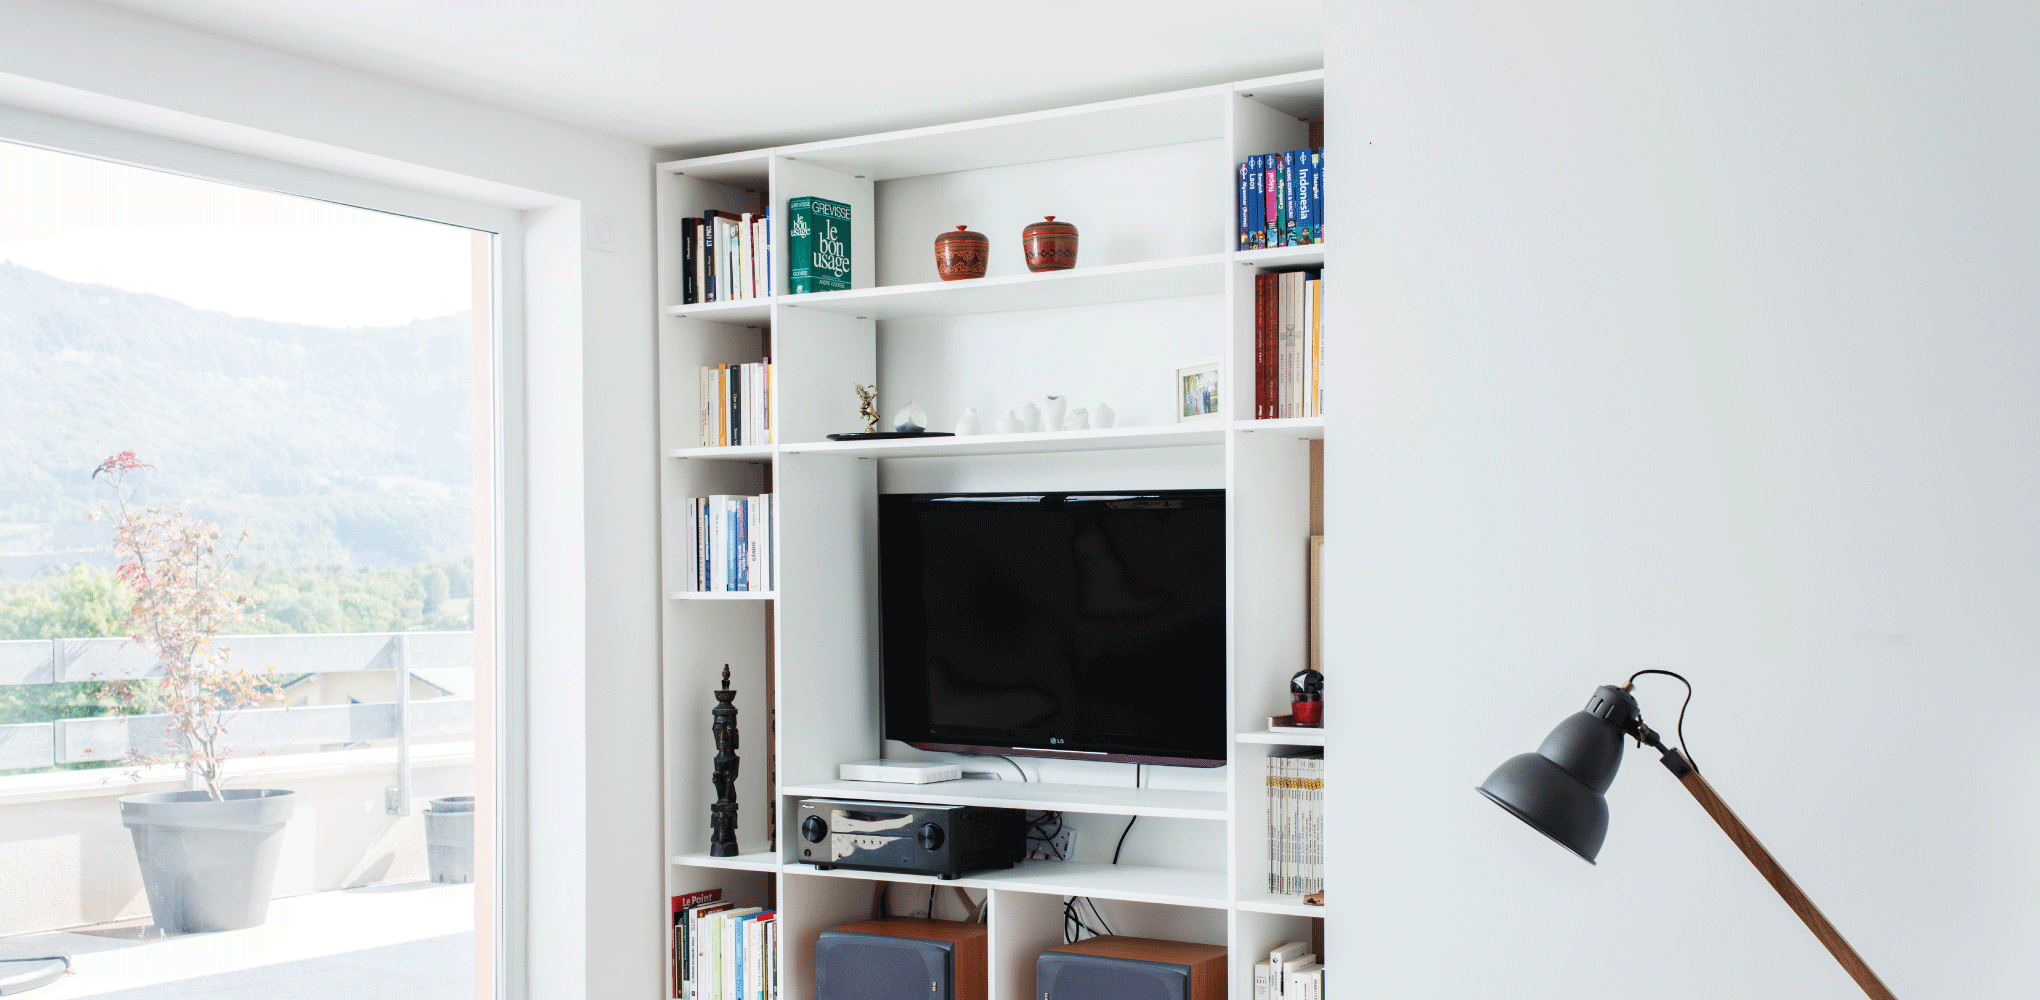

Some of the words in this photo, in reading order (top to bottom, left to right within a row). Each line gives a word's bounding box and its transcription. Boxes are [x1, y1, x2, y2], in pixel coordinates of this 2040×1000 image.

[1299, 168, 1310, 220] Indonesia
[796, 214, 804, 223] le
[812, 202, 851, 220] GREVISSE
[790, 227, 811, 238] usage
[794, 220, 807, 230] bon
[826, 219, 838, 241] le
[819, 232, 844, 257] bon
[813, 252, 850, 277] usage
[682, 897, 690, 906] Le
[692, 893, 712, 904] Point
